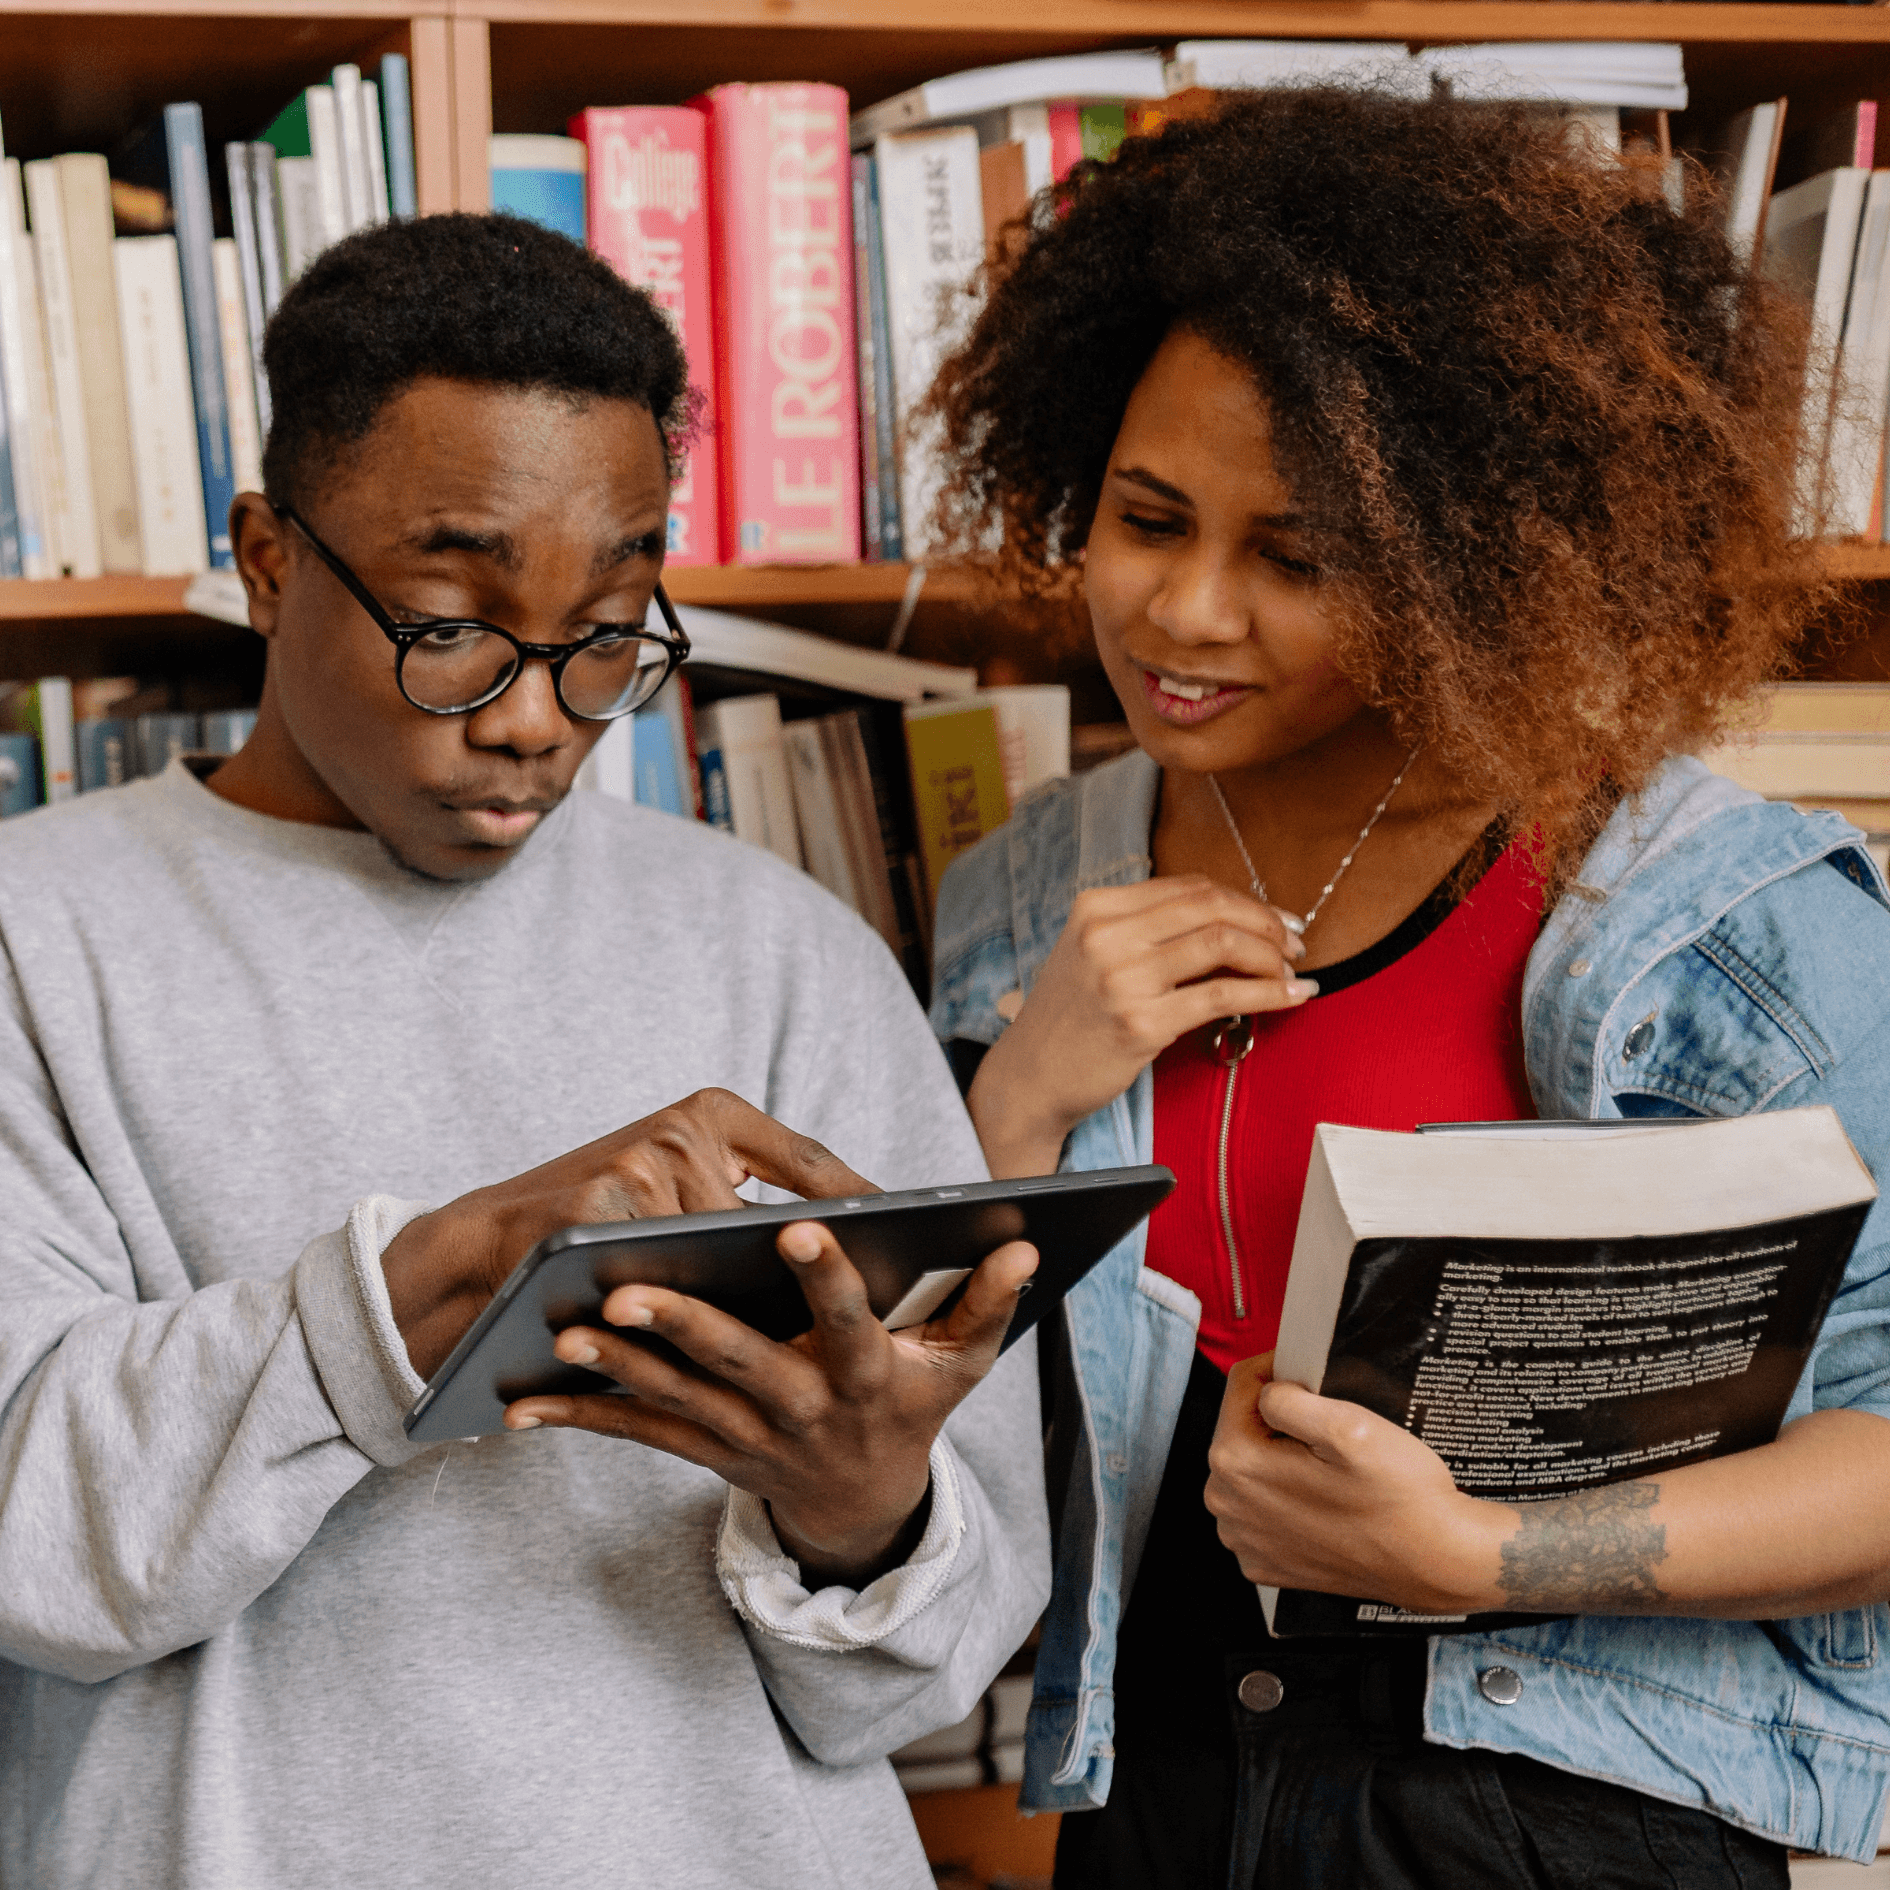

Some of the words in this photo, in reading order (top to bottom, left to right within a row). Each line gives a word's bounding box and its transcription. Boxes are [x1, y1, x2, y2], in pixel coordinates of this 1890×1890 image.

[769, 90, 844, 439] ROBERT
[776, 459, 845, 555] LE
[1444, 1262, 1504, 1273] Marketing
[1607, 1263, 1656, 1273] textbook
[1442, 1272, 1503, 1282] marketing.
[1438, 1284, 1491, 1295] Carefully
[1493, 1287, 1553, 1296] developed
[1555, 1288, 1593, 1296] design
[1594, 1287, 1640, 1295] features
[1437, 1293, 1458, 1302] ally
[1563, 1297, 1609, 1305] learning
[1454, 1304, 1520, 1313] at-a-glance
[1521, 1306, 1562, 1314] margin
[1483, 1313, 1568, 1322] clearly-marked
[1602, 1312, 1615, 1320] of
[1481, 1322, 1536, 1330] advanced
[1538, 1323, 1583, 1331] students
[1447, 1329, 1491, 1338] revision
[1493, 1331, 1545, 1340] questions
[1561, 1331, 1581, 1339] aid
[1582, 1329, 1622, 1338] student
[1623, 1326, 1668, 1336] learning
[1445, 1338, 1486, 1346] special
[1488, 1340, 1529, 1348] project
[1532, 1341, 1585, 1349] questions
[1604, 1337, 1642, 1345] enable
[1442, 1347, 1491, 1355] practice.
[1418, 1365, 1474, 1376] marketing
[1571, 1367, 1619, 1377] company
[1620, 1358, 1689, 1373] performance.
[1421, 1356, 1479, 1368] Marketing
[1484, 1360, 1494, 1368] is
[1524, 1361, 1576, 1369] complete
[1581, 1359, 1613, 1369] guide
[1416, 1373, 1469, 1384] providing
[1473, 1377, 1554, 1386] comprehensive
[1558, 1376, 1609, 1385] coverage
[1612, 1373, 1624, 1381] of
[1414, 1381, 1466, 1392] functions,
[1517, 1385, 1584, 1394] applications
[1586, 1383, 1608, 1392] and
[1609, 1381, 1640, 1389] issues
[1412, 1390, 1485, 1401] not-for-profit
[1556, 1389, 1629, 1401] developments
[1410, 1398, 1455, 1407] practice
[1477, 1402, 1532, 1411] examined,
[1534, 1402, 1587, 1410] including:
[1427, 1407, 1477, 1417] precision
[1478, 1410, 1533, 1420] marketing
[1423, 1423, 1500, 1434] environmental
[1455, 1418, 1509, 1427] marketing
[1421, 1431, 1476, 1441] conviction
[1478, 1434, 1532, 1443] marketing
[1471, 1442, 1513, 1450] product
[1515, 1441, 1583, 1450] development
[1454, 1461, 1463, 1469] is
[1468, 1462, 1509, 1470] suitable
[1513, 1462, 1529, 1470] for
[1551, 1457, 1603, 1468] marketing
[1451, 1470, 1515, 1478] professional
[1516, 1465, 1587, 1478] examinations,
[1564, 1472, 1607, 1482] degrees.
